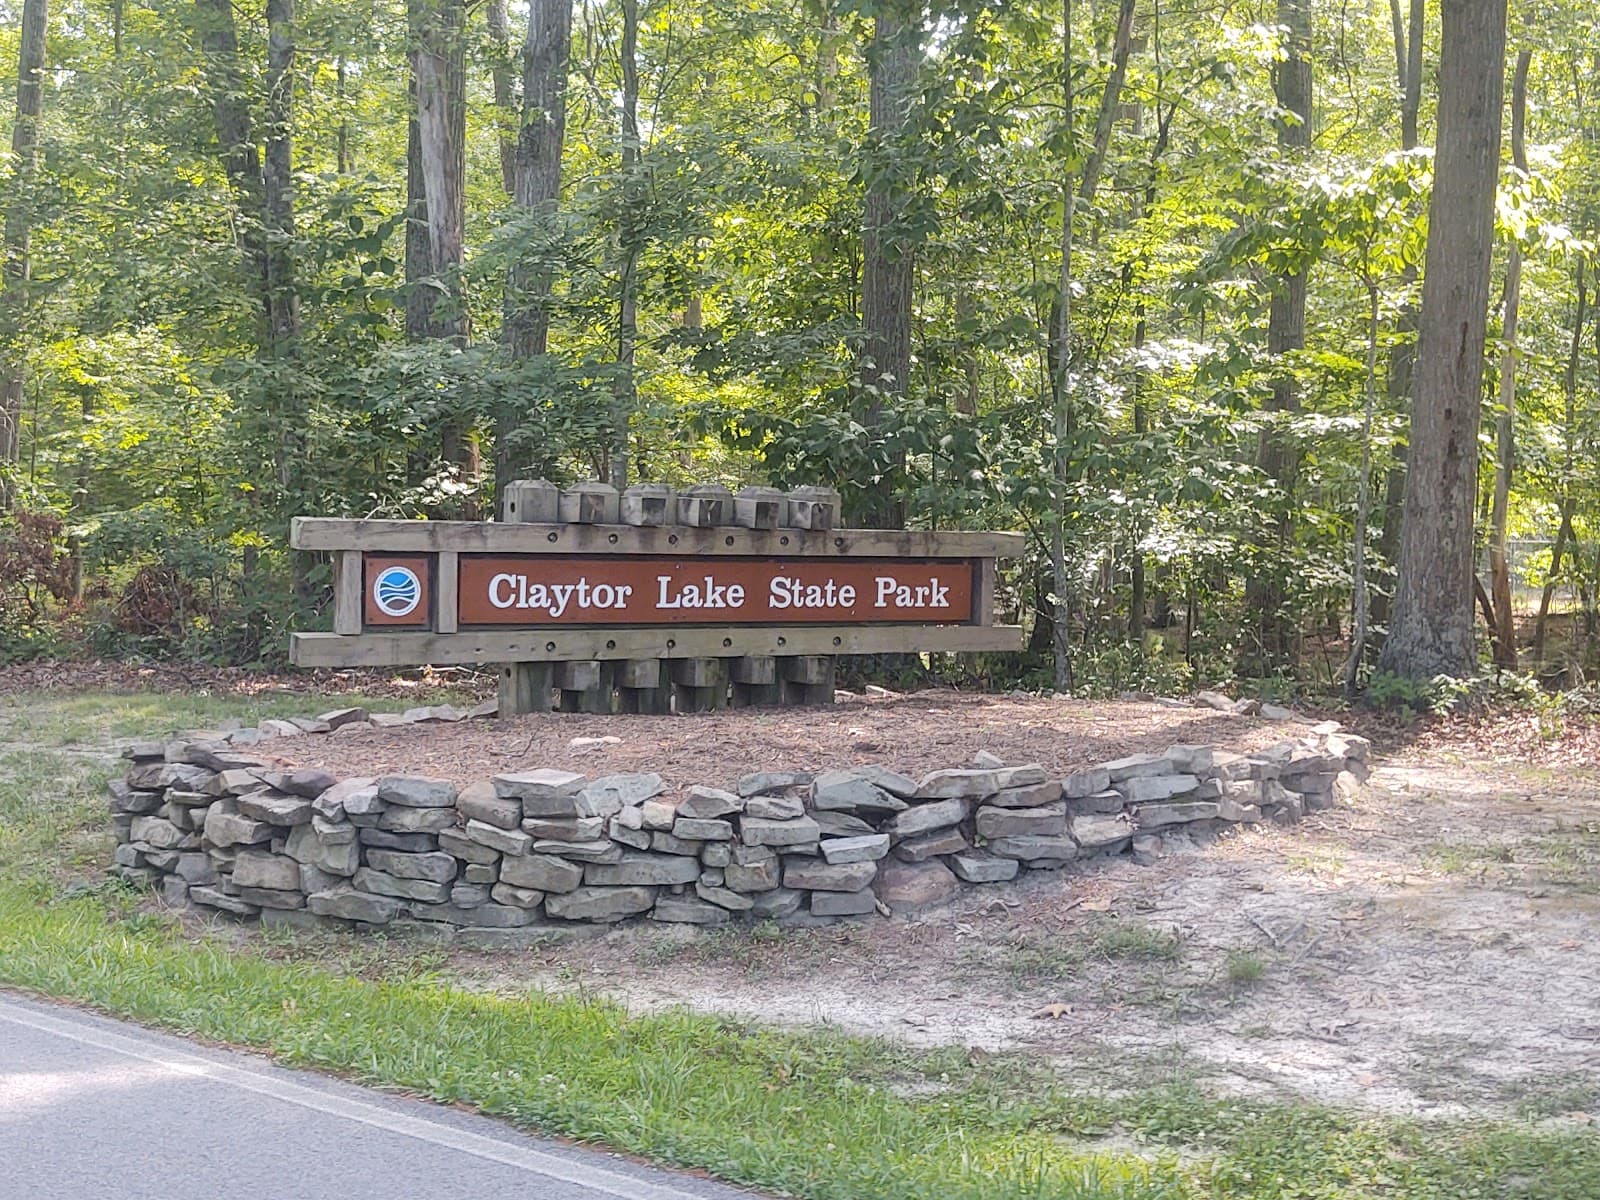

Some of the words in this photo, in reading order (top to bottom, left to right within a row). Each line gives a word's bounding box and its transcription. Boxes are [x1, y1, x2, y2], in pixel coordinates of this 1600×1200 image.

[488, 573, 633, 617] Claytor
[655, 576, 745, 609] Lake
[769, 576, 856, 608] State
[874, 577, 950, 608] Park
